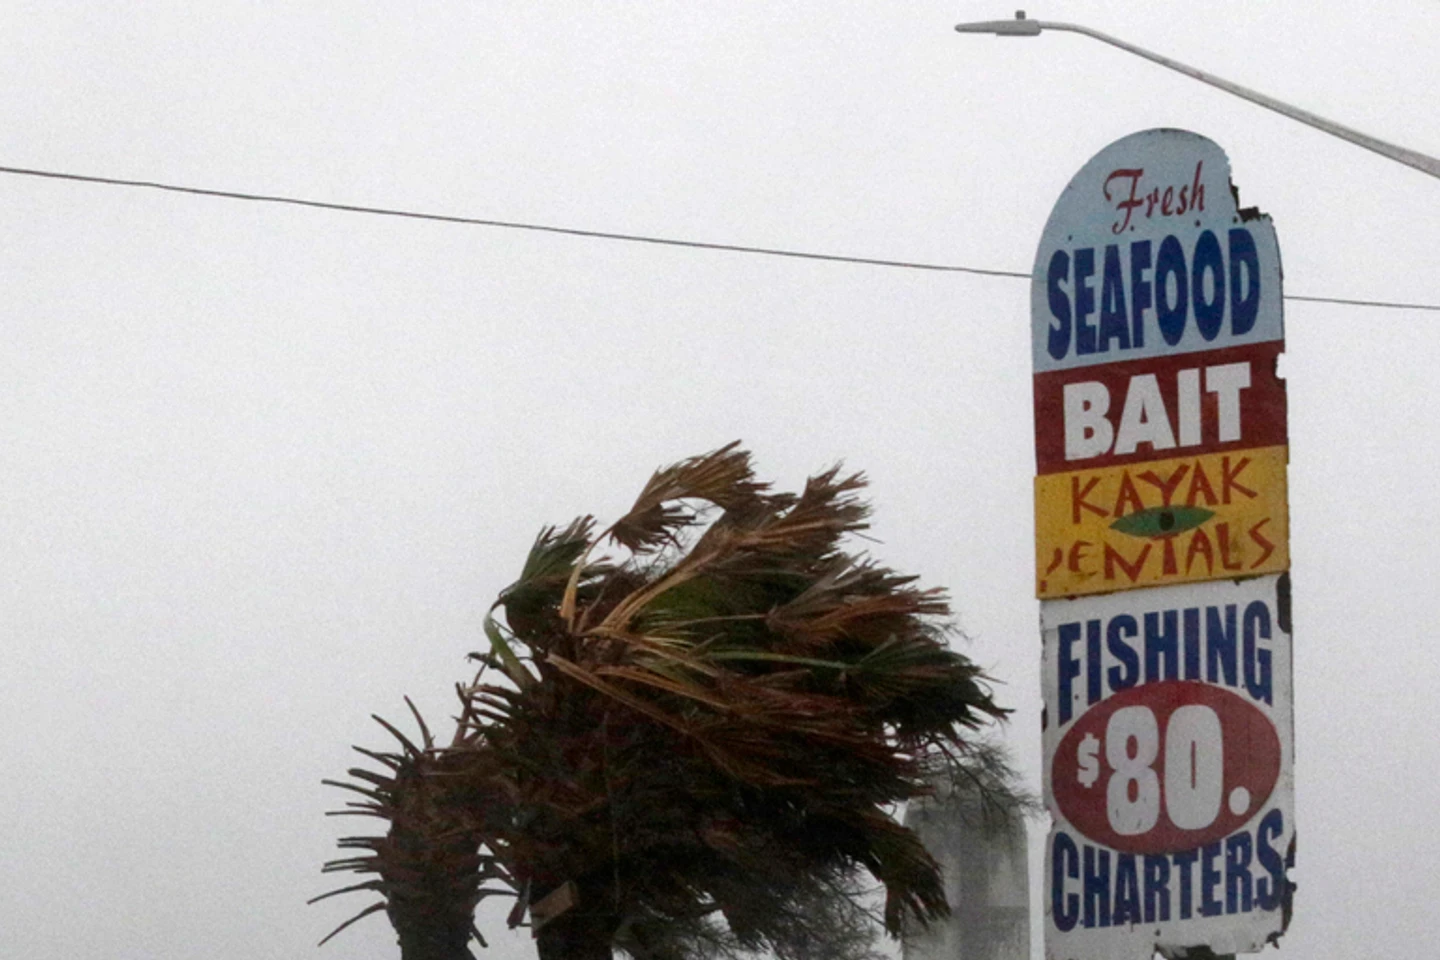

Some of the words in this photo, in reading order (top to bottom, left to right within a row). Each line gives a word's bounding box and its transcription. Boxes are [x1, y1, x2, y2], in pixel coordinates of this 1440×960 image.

[1103, 160, 1206, 235] Fresh
[1047, 227, 1261, 361] SEAFOOD
[1062, 361, 1252, 462] BAIT
[1071, 456, 1259, 525] KAYAK
[1057, 600, 1273, 728] FISHING
[1051, 808, 1284, 932] CHARTERS
